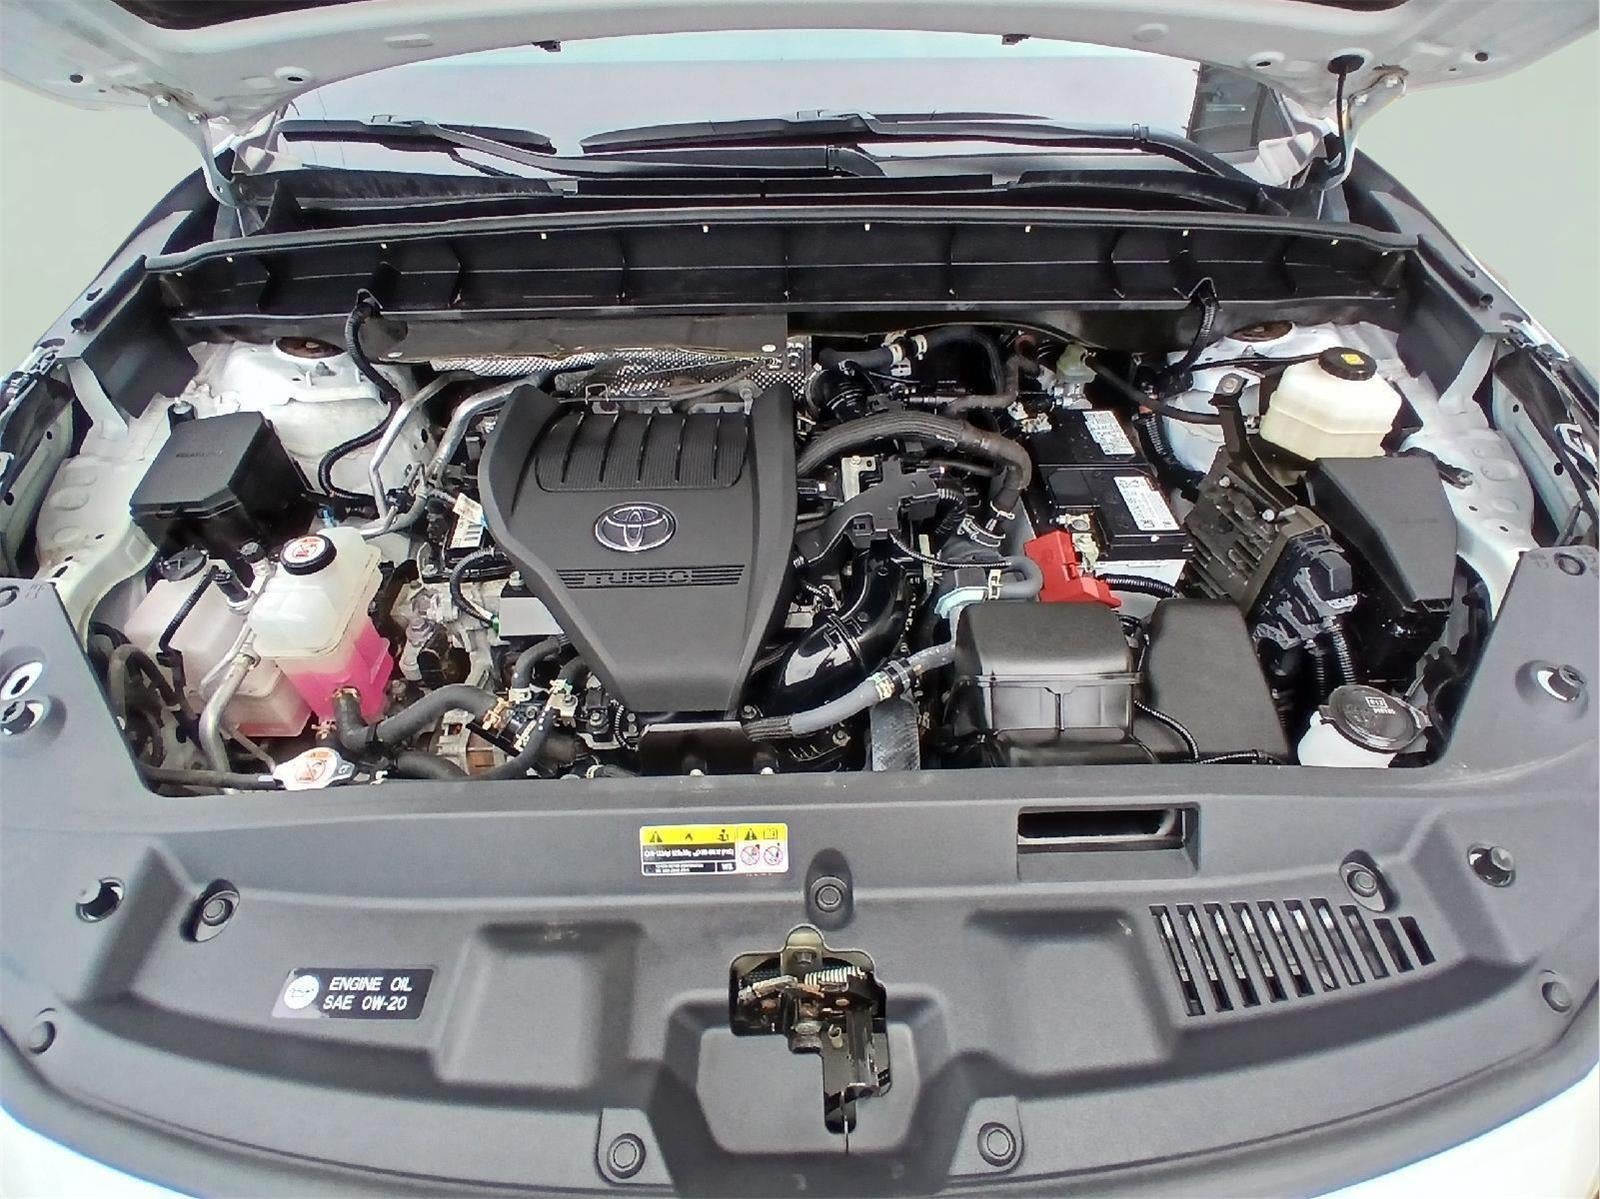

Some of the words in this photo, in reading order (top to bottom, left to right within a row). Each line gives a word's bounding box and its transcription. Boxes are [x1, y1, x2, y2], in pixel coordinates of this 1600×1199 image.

[587, 570, 689, 585] TURBO
[329, 976, 384, 992] ENGINE
[390, 976, 413, 992] OIL
[323, 995, 355, 1011] SAE
[361, 995, 408, 1011] 0W-20
